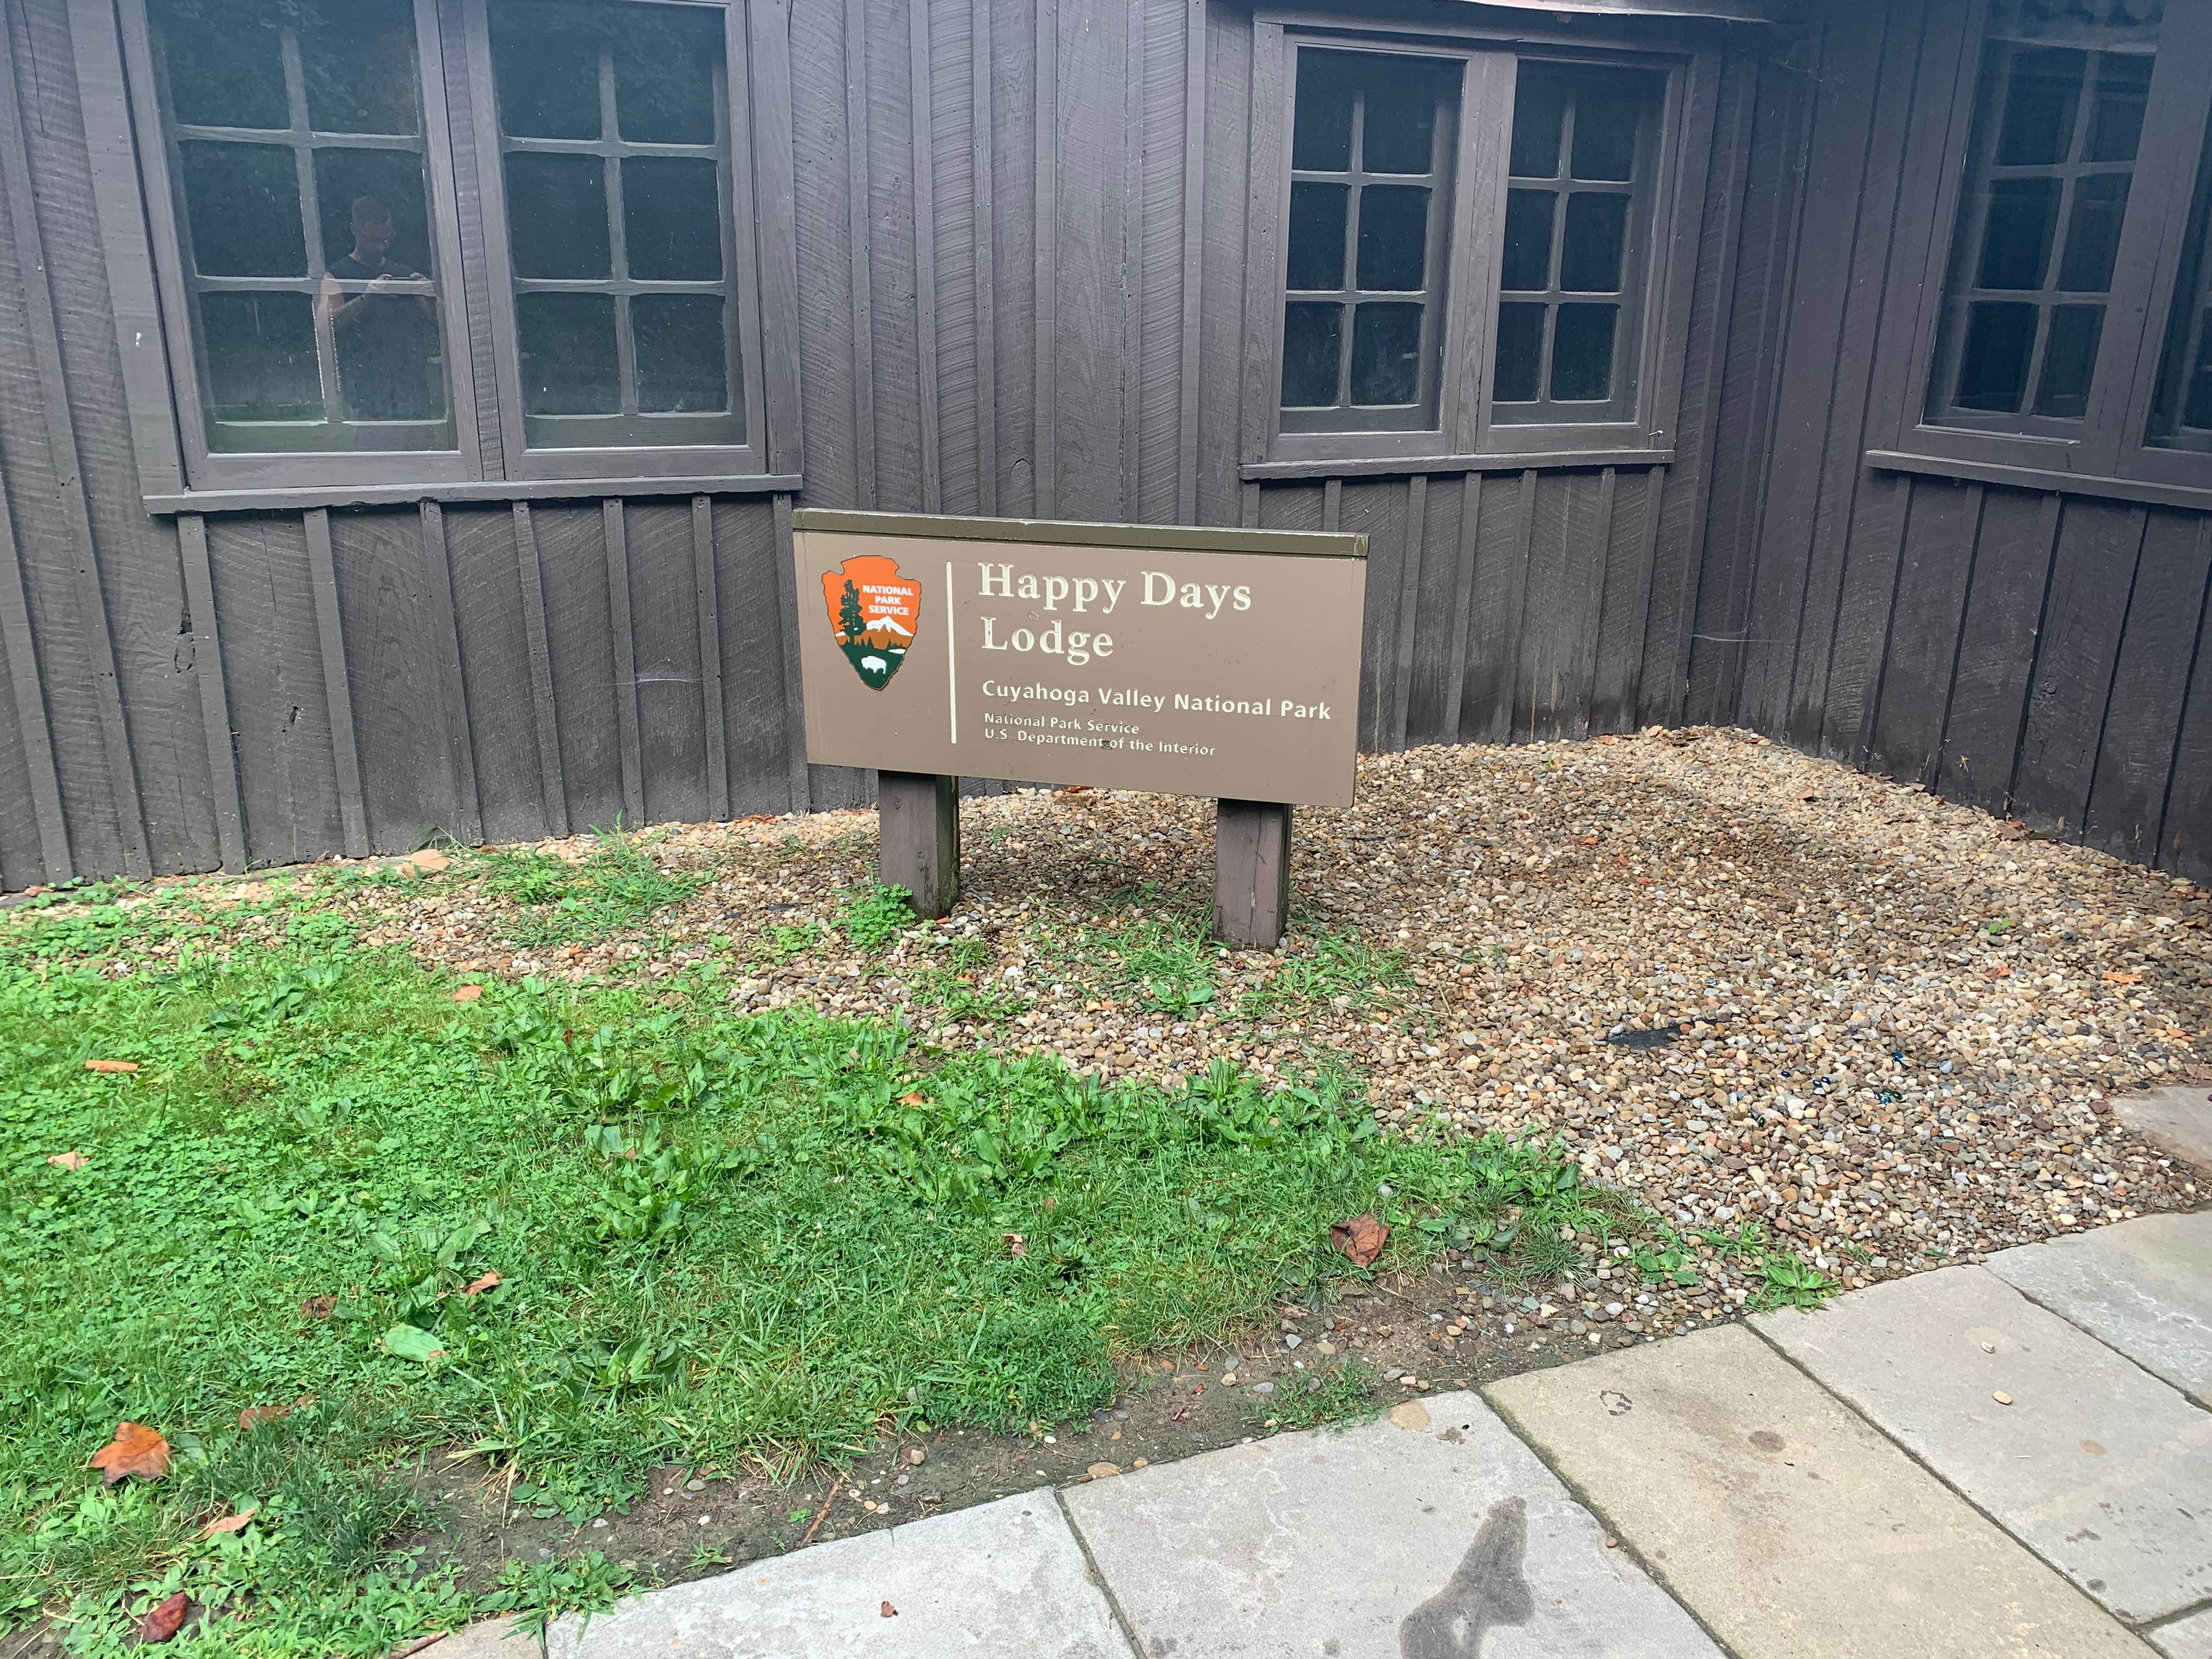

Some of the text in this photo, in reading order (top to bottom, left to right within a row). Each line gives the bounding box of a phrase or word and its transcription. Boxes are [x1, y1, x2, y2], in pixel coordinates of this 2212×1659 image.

[862, 585, 914, 596] NATIONAL
[875, 595, 902, 605] PARK
[978, 562, 1251, 619] Happy Days
[868, 605, 910, 616] SERVICE
[980, 616, 1114, 665] Lodge
[982, 679, 1331, 720] Cuyahoga Valley National Park
[984, 712, 1139, 734] National Park Service
[1018, 730, 1103, 747] Department
[1109, 737, 1124, 749] of
[1129, 740, 1153, 751] the
[1158, 741, 1216, 755] Interior
